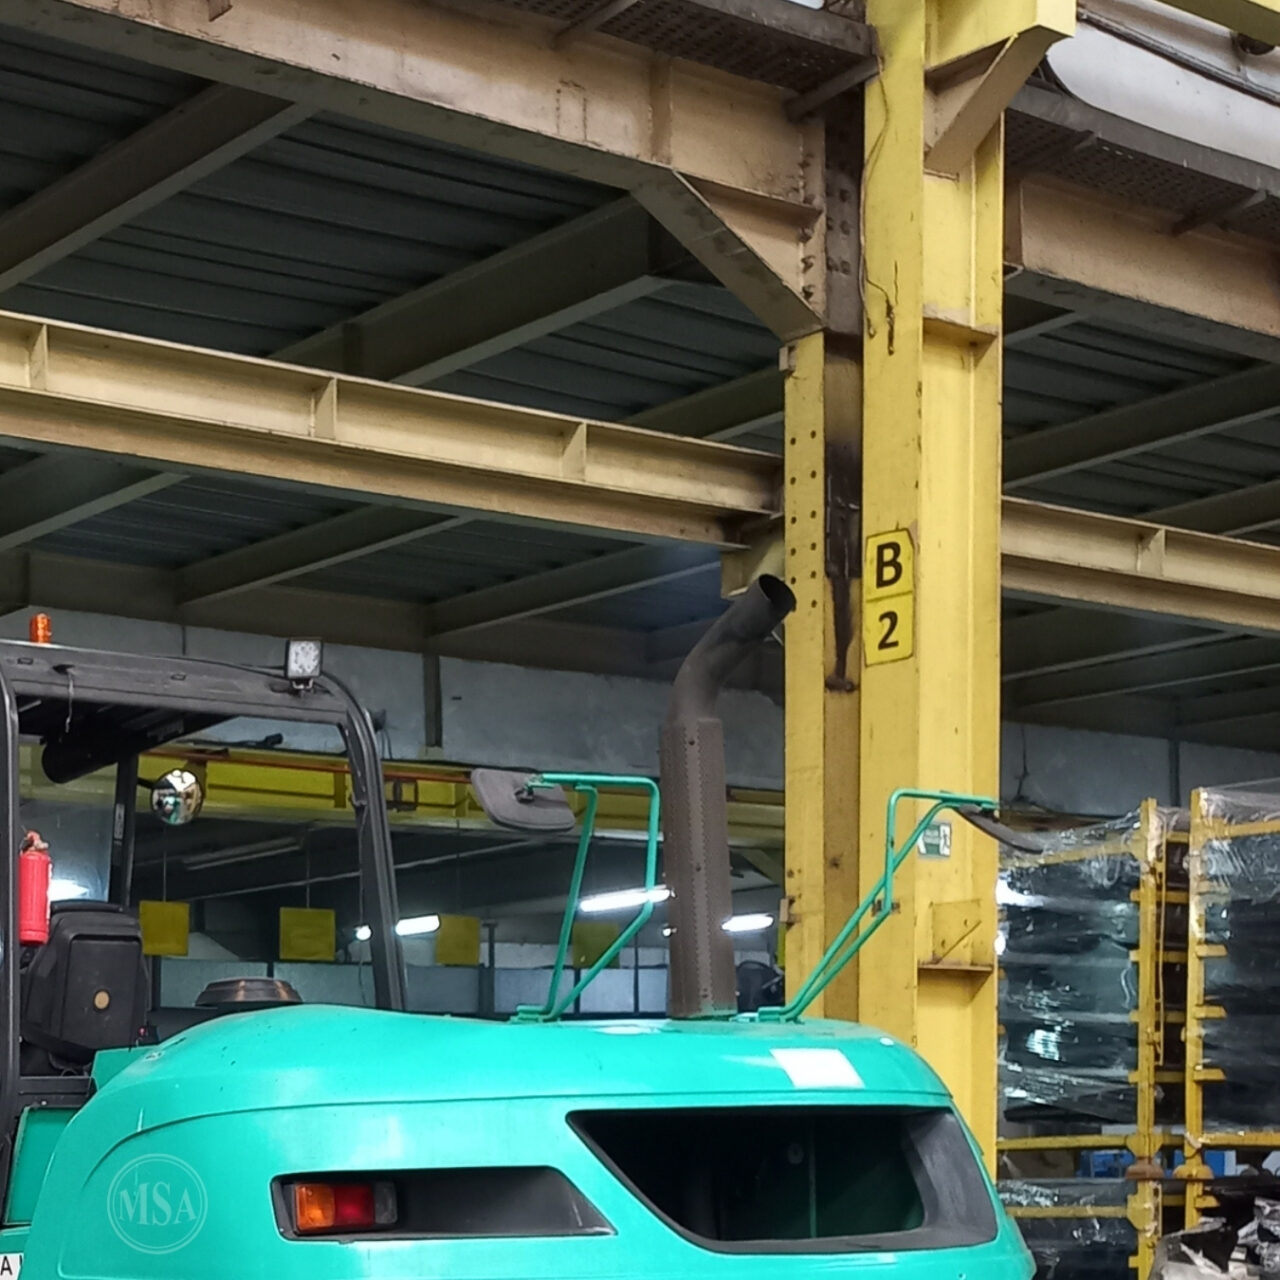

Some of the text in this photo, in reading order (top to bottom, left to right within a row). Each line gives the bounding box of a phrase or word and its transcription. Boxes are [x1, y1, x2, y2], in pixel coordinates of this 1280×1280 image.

[876, 541, 903, 589] B
[877, 611, 899, 650] 2
[118, 1180, 197, 1226] MSA
